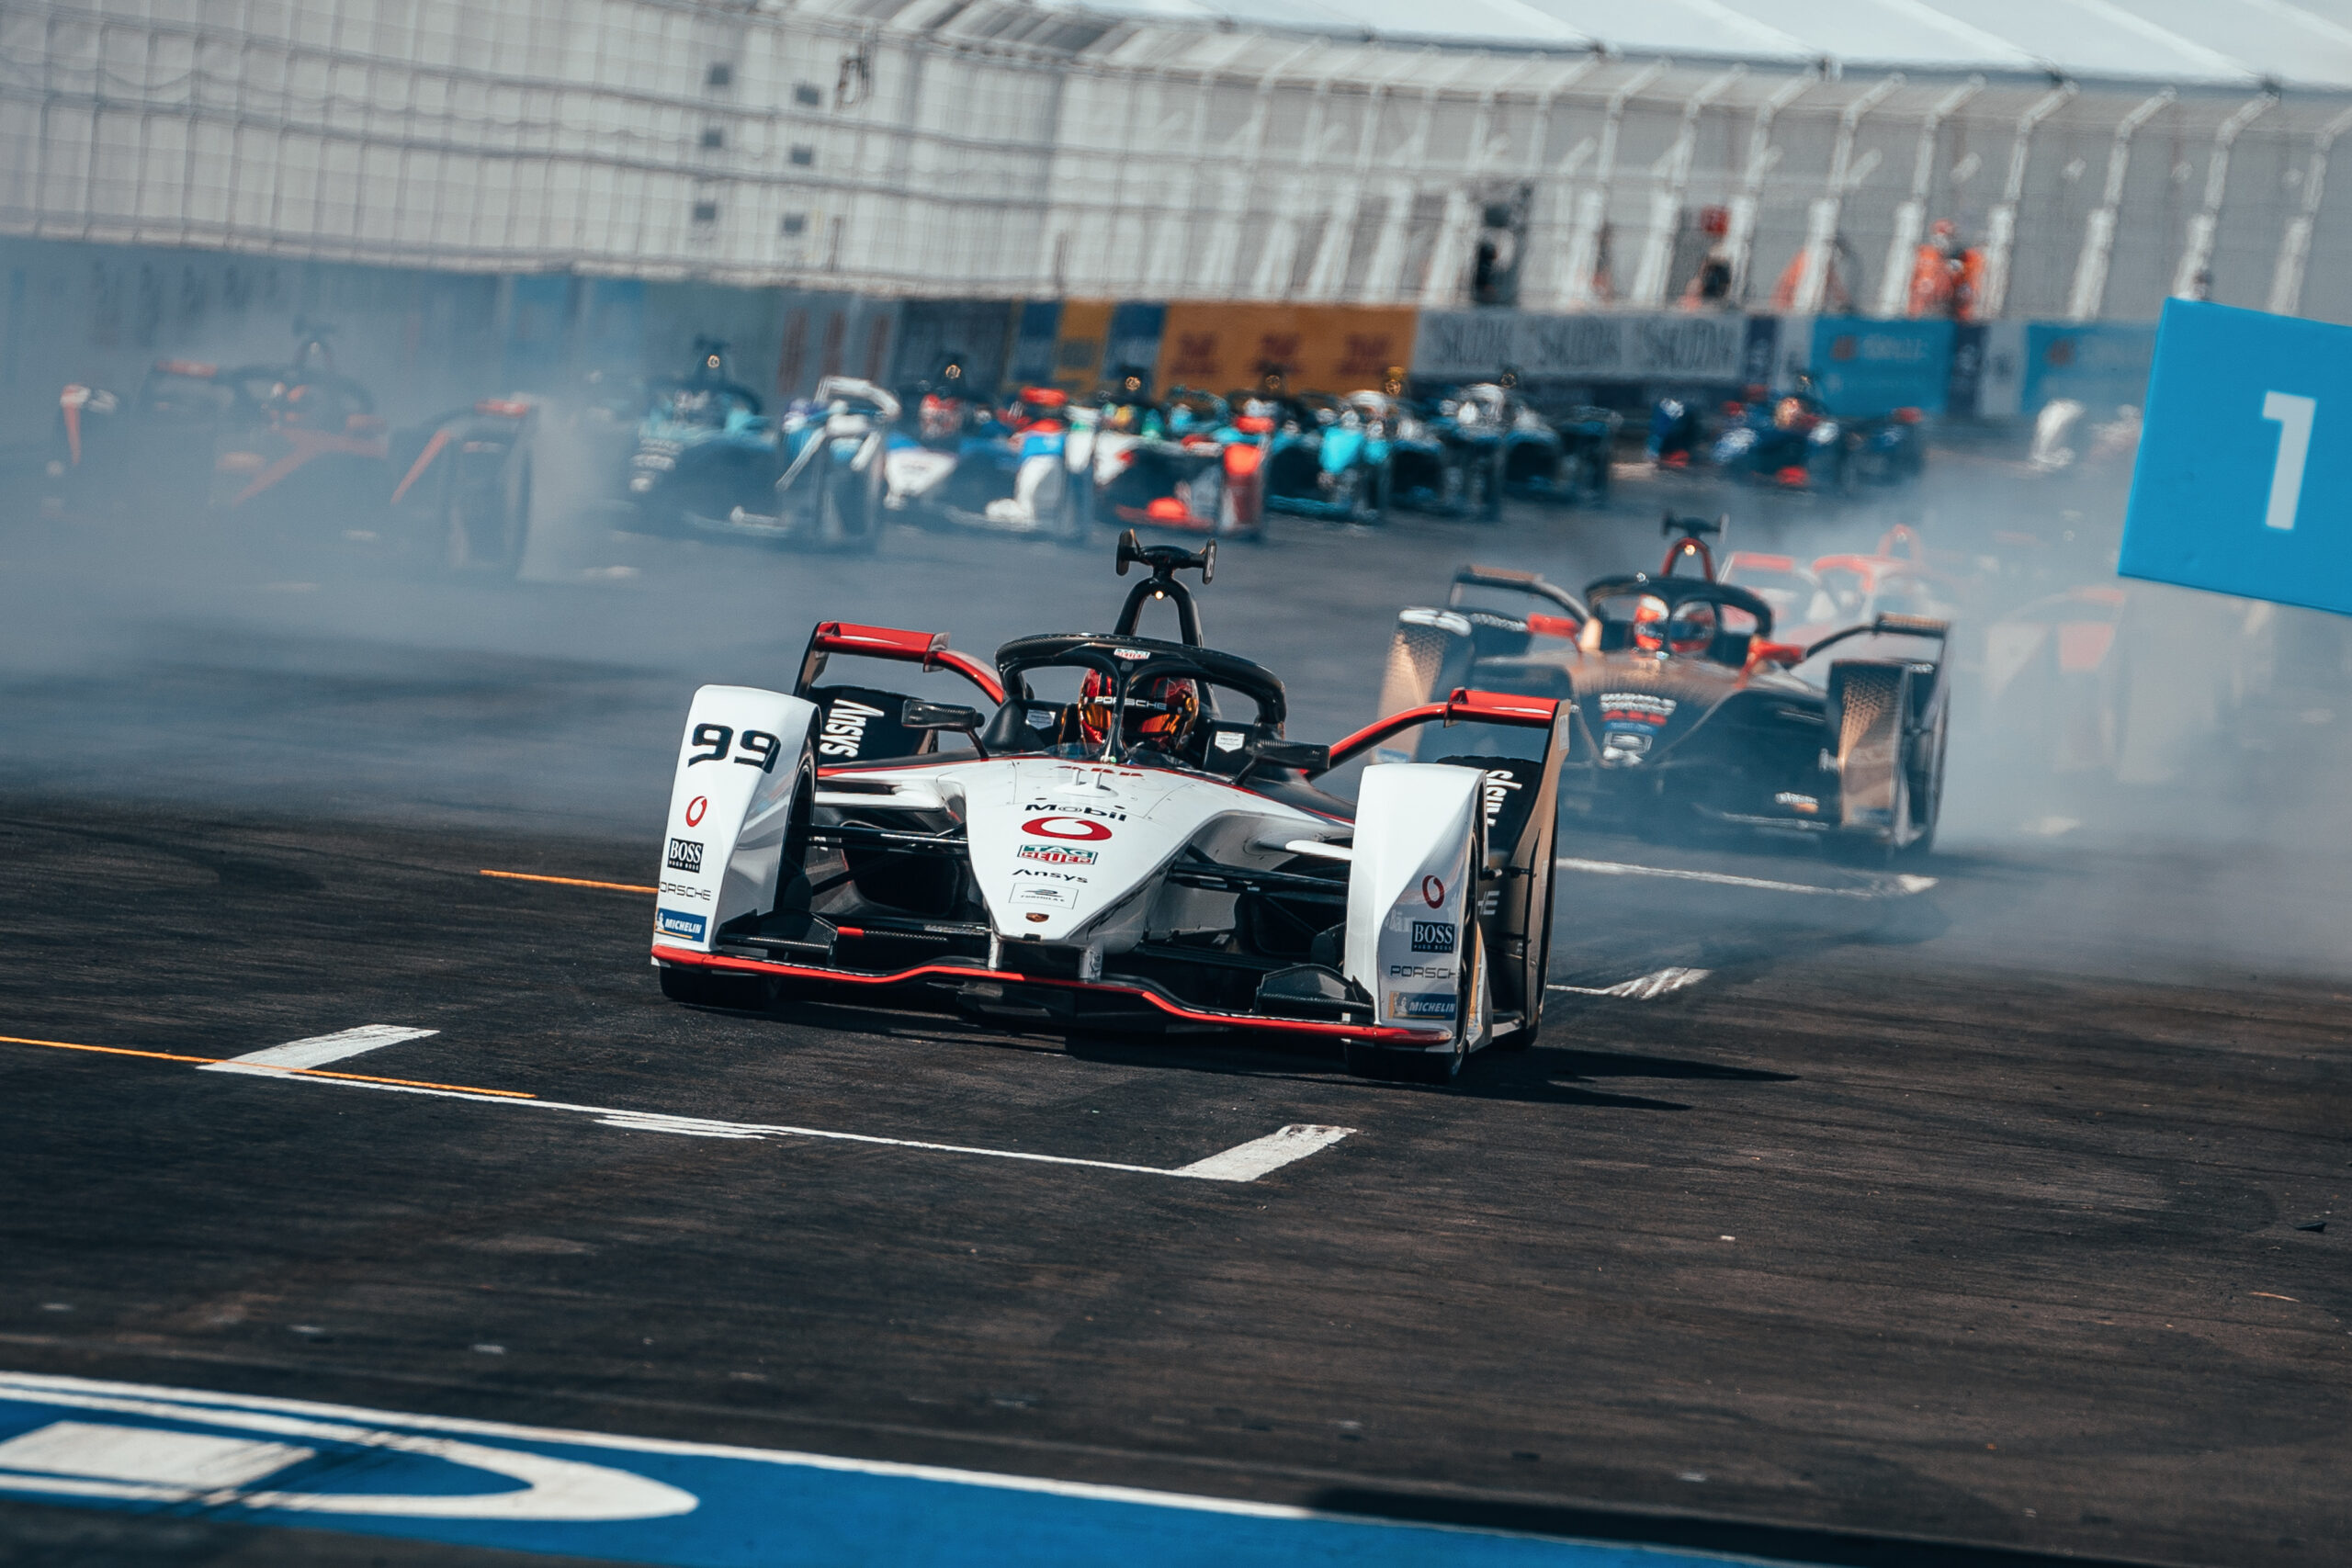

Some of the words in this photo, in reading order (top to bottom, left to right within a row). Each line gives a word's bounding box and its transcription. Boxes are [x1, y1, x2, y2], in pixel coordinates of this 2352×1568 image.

[2262, 390, 2316, 530] 1
[820, 698, 885, 758] Ansys
[688, 723, 782, 773] 99
[1024, 804, 1127, 822] Mobil
[669, 840, 702, 863] BOSS
[1022, 852, 1091, 863] HEUER
[1024, 845, 1090, 858] TAG
[1012, 868, 1088, 883] Ansys
[658, 882, 711, 901] ORSCHE
[664, 918, 703, 934] MICHELIN
[1414, 924, 1453, 944] BOSS
[1390, 964, 1461, 979] PORSCH
